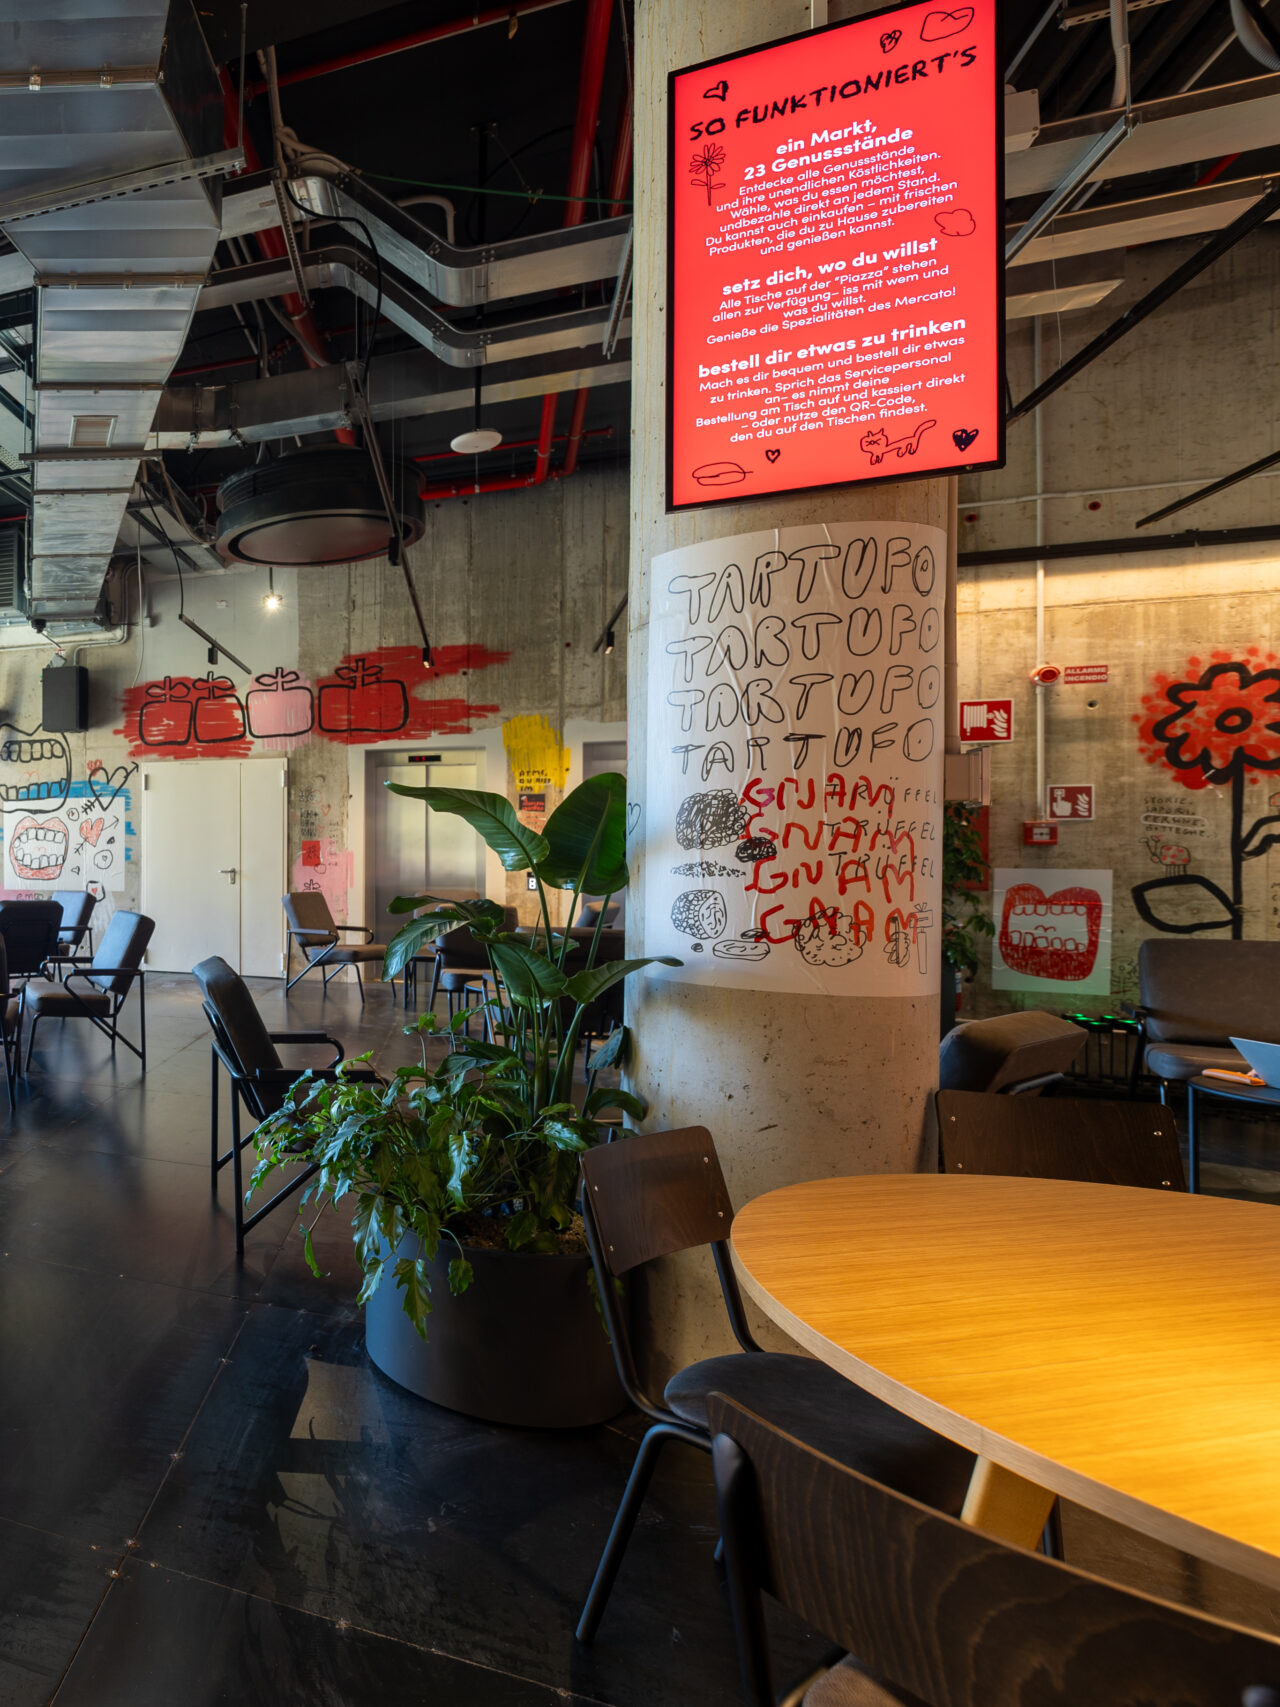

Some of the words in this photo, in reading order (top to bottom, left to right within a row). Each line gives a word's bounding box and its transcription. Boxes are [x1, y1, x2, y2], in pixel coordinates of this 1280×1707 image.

[690, 117, 725, 141] SO
[743, 163, 766, 181] 23
[771, 127, 914, 173] Genussstände
[775, 138, 805, 155] ein
[810, 119, 877, 147] Markt,
[716, 198, 739, 213] und
[742, 194, 766, 206] ihre
[768, 174, 845, 200] unendlichen
[848, 152, 941, 180] Köstlichkeiten.
[730, 203, 771, 219] Wähle,
[773, 196, 799, 209] was
[801, 191, 819, 202] du
[821, 182, 858, 197] essen
[861, 165, 925, 188] möchtest,
[739, 176, 794, 196] Entdecke
[796, 168, 820, 181] alle
[822, 145, 915, 175] Genussstände
[705, 236, 722, 247] Du
[725, 225, 765, 242] kannst
[767, 217, 798, 232] auch
[801, 203, 864, 224] einkaufen
[879, 192, 901, 206] mit
[903, 181, 958, 200] frischen
[709, 236, 773, 257] Produkten,
[776, 229, 796, 241] die
[798, 224, 815, 236] du
[818, 221, 834, 232] zu
[837, 211, 878, 227] Hause
[881, 194, 954, 217] zubereiten
[719, 208, 791, 233] undbezahle
[794, 198, 830, 215] direkt
[832, 195, 850, 206] an
[853, 185, 894, 204] jedem
[897, 172, 941, 190] Stand.
[760, 241, 784, 255] und
[786, 229, 846, 252] genießen
[849, 217, 895, 235] kannst.
[719, 298, 742, 311] Alle
[744, 290, 783, 305] Tische
[785, 282, 807, 296] auf
[809, 280, 832, 291] der
[892, 258, 937, 274] stehen
[722, 278, 761, 296] setz
[765, 265, 813, 286] dich,
[817, 260, 847, 275] wo
[851, 251, 878, 267] du
[882, 237, 938, 261] willst
[706, 327, 757, 345] Genieße
[759, 323, 779, 334] die
[781, 307, 865, 331] Spezialitäten
[867, 301, 892, 313] des
[894, 286, 956, 308] Mercato!
[712, 310, 742, 323] allen
[744, 305, 765, 316] zur
[842, 286, 859, 296] iss
[862, 279, 883, 292] mit
[886, 273, 919, 286] wem
[922, 264, 949, 279] und
[782, 307, 809, 319] was
[811, 302, 828, 313] du
[831, 294, 866, 309] willst.
[698, 353, 760, 379] bestell
[764, 348, 793, 366] dir
[796, 339, 857, 359] etwas
[861, 333, 886, 348] zu
[890, 318, 966, 342] trinken
[699, 377, 734, 392] Mach
[736, 376, 750, 385] es
[752, 371, 770, 382] dir
[772, 362, 825, 379] bequem
[827, 354, 853, 368] und
[855, 345, 899, 363] bestell
[902, 343, 922, 355] dir
[923, 336, 965, 351] etwas
[695, 410, 758, 428] Bestellung
[760, 406, 781, 417] am
[783, 398, 815, 413] Tisch
[818, 393, 841, 407] auf
[842, 388, 868, 402] und
[871, 380, 923, 398] kassiert
[925, 373, 966, 388] direkt
[709, 394, 725, 404] zu
[727, 387, 772, 401] trinken.
[774, 376, 815, 394] Sprich
[817, 373, 842, 385] das
[844, 351, 952, 380] Servicepersonal
[791, 391, 806, 400] es
[808, 381, 850, 397] nimmt
[852, 376, 890, 390] deine
[729, 432, 754, 443] den
[756, 428, 773, 439] du
[775, 422, 797, 436] auf
[799, 420, 824, 432] den
[826, 412, 876, 427] Tischen
[879, 402, 928, 419] findest.
[751, 416, 782, 429] oder
[783, 411, 819, 424] nutze
[821, 406, 847, 417] den
[849, 393, 916, 413] QR-Code,
[668, 537, 936, 625] TARTUFO
[664, 604, 940, 683] TARTUFO
[1065, 666, 1106, 674] ALLARME
[666, 665, 940, 731] TARTUFO
[1064, 674, 1108, 682] INCENDIO
[671, 718, 935, 782] TARTUFO
[738, 773, 895, 818] GNAM
[824, 776, 937, 805] TRÜFFEL
[738, 813, 915, 867] GNAM
[823, 810, 936, 841] TRÜFFEL
[745, 855, 915, 903] GNAM
[828, 844, 934, 879] TRÜFFEL
